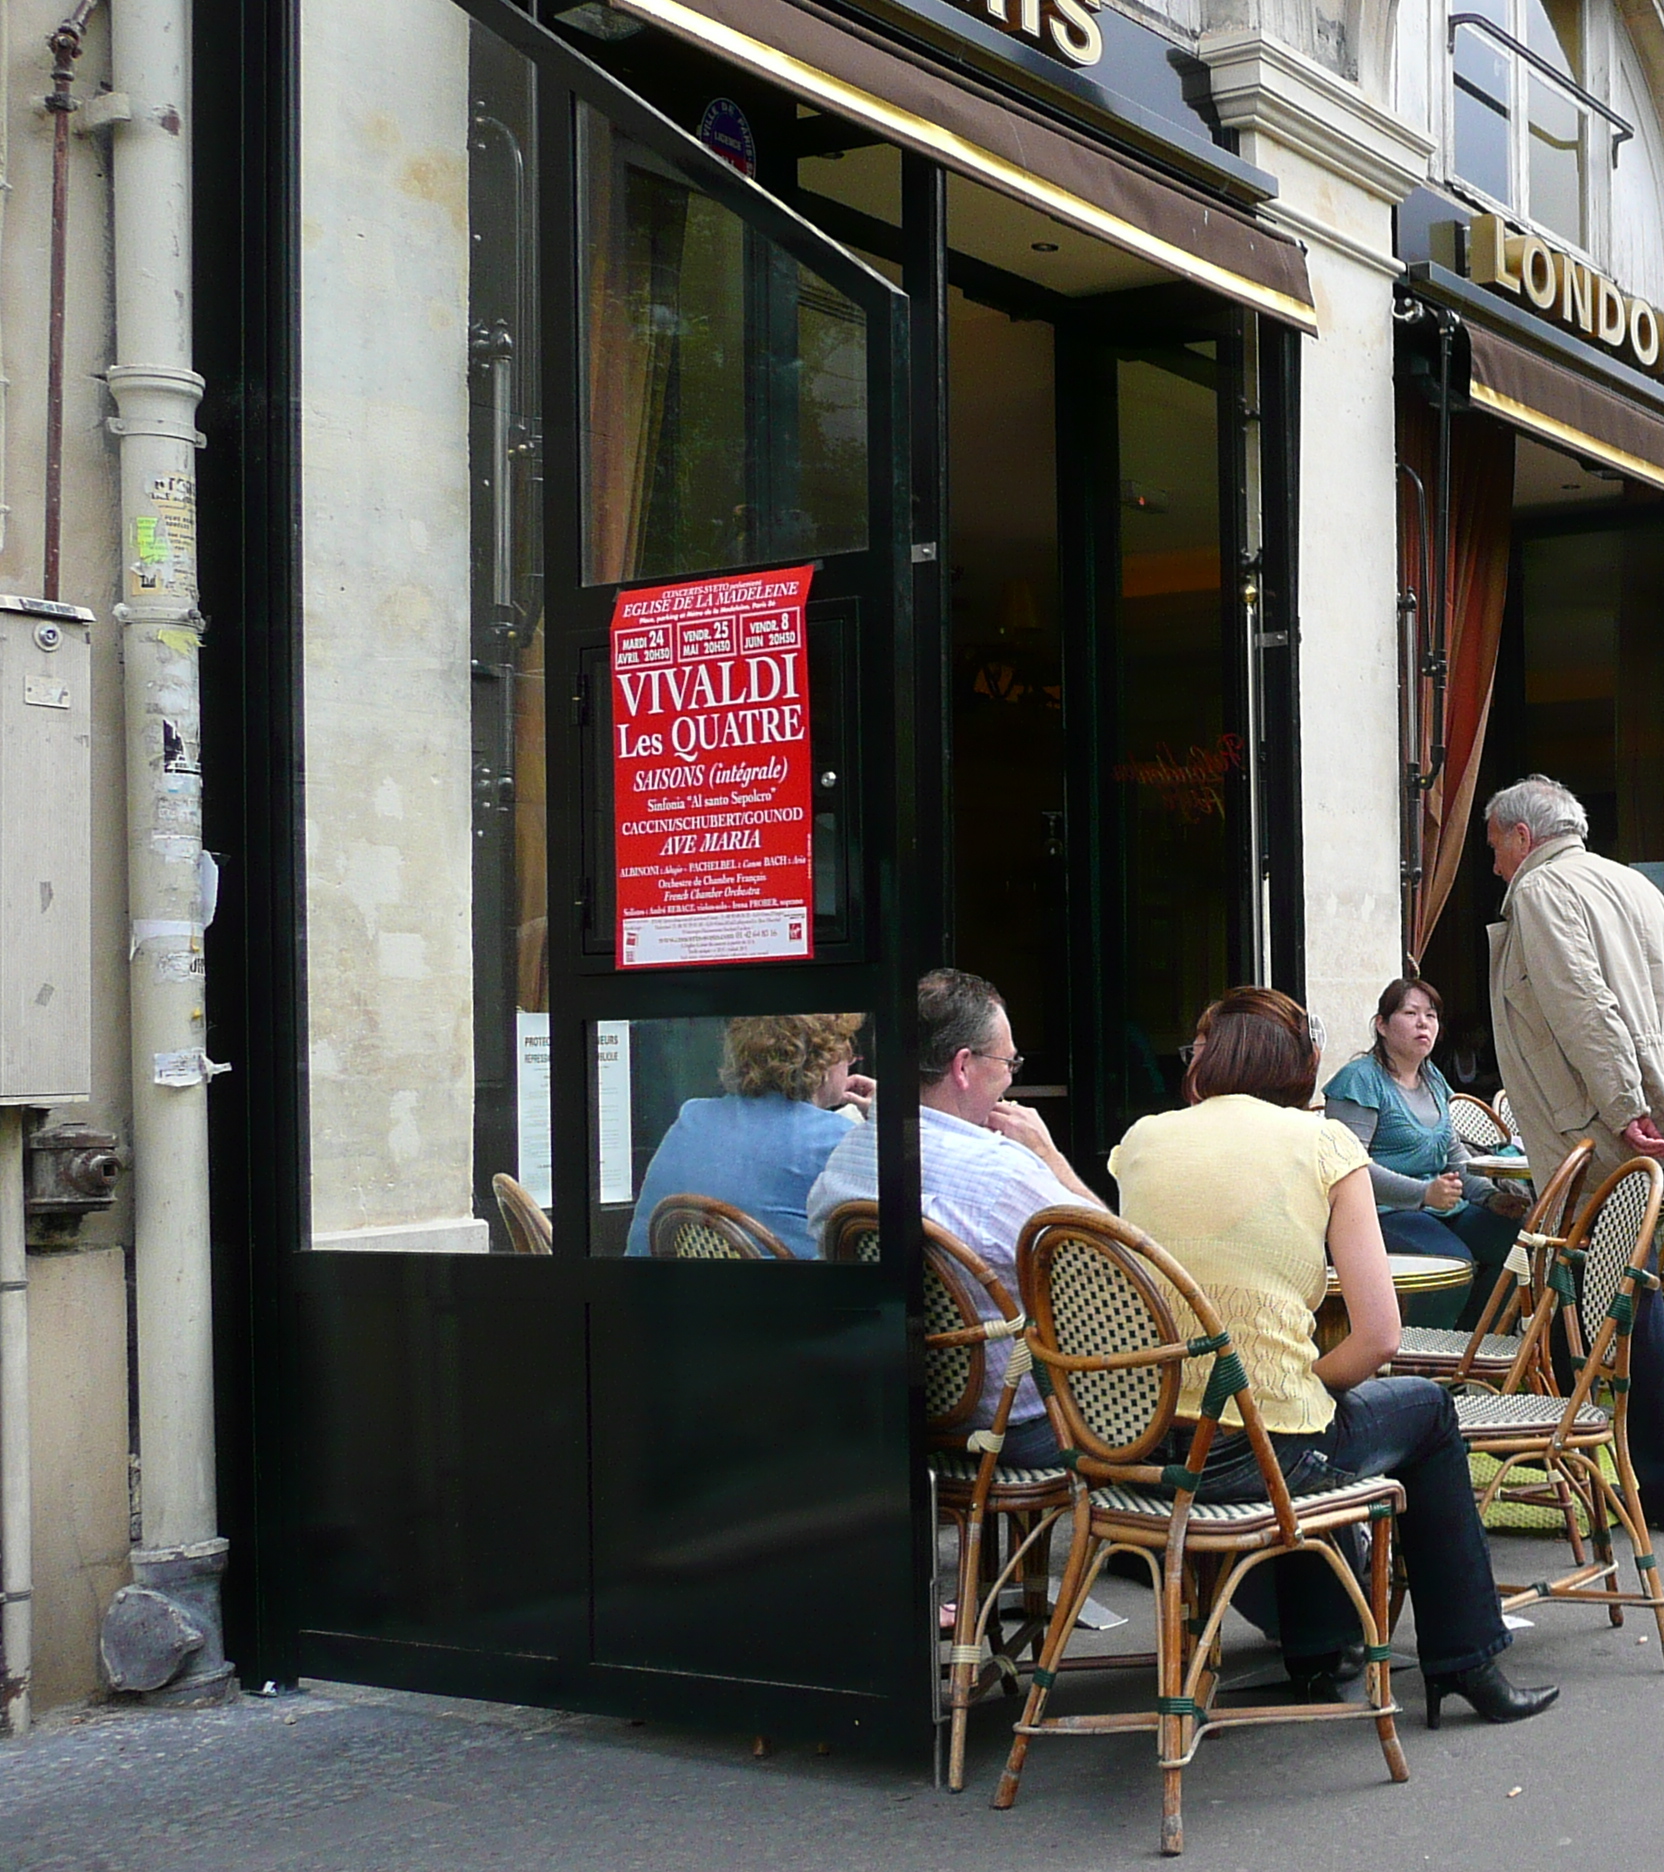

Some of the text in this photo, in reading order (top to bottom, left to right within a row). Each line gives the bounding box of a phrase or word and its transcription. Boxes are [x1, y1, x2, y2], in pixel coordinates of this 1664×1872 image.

[623, 581, 799, 618] EGLISE DE LA MADELEINE
[713, 621, 729, 639] 25
[781, 612, 789, 630] 8
[622, 630, 664, 651] MARDI 24
[683, 640, 731, 657] MAI 20H30
[744, 631, 796, 650] JUIN 20H30
[617, 647, 671, 665] AVRIL 20H30
[616, 653, 800, 717] VIVALDI
[616, 704, 805, 762] Les QUATRE
[633, 755, 788, 792] SAISONS (intégrale)
[647, 795, 686, 812] Sinfonia
[704, 794, 729, 808] santo
[622, 806, 803, 836] CACCINI/SCHUBERT/GOUNOD
[659, 829, 762, 856] AVE MARIA
[689, 860, 737, 874] PACHELBEL
[763, 855, 787, 868] BACH
[658, 875, 693, 889] Orchestre
[694, 875, 702, 887] de
[703, 872, 735, 886] Chambre
[663, 885, 760, 902] French Chamber Orchestra
